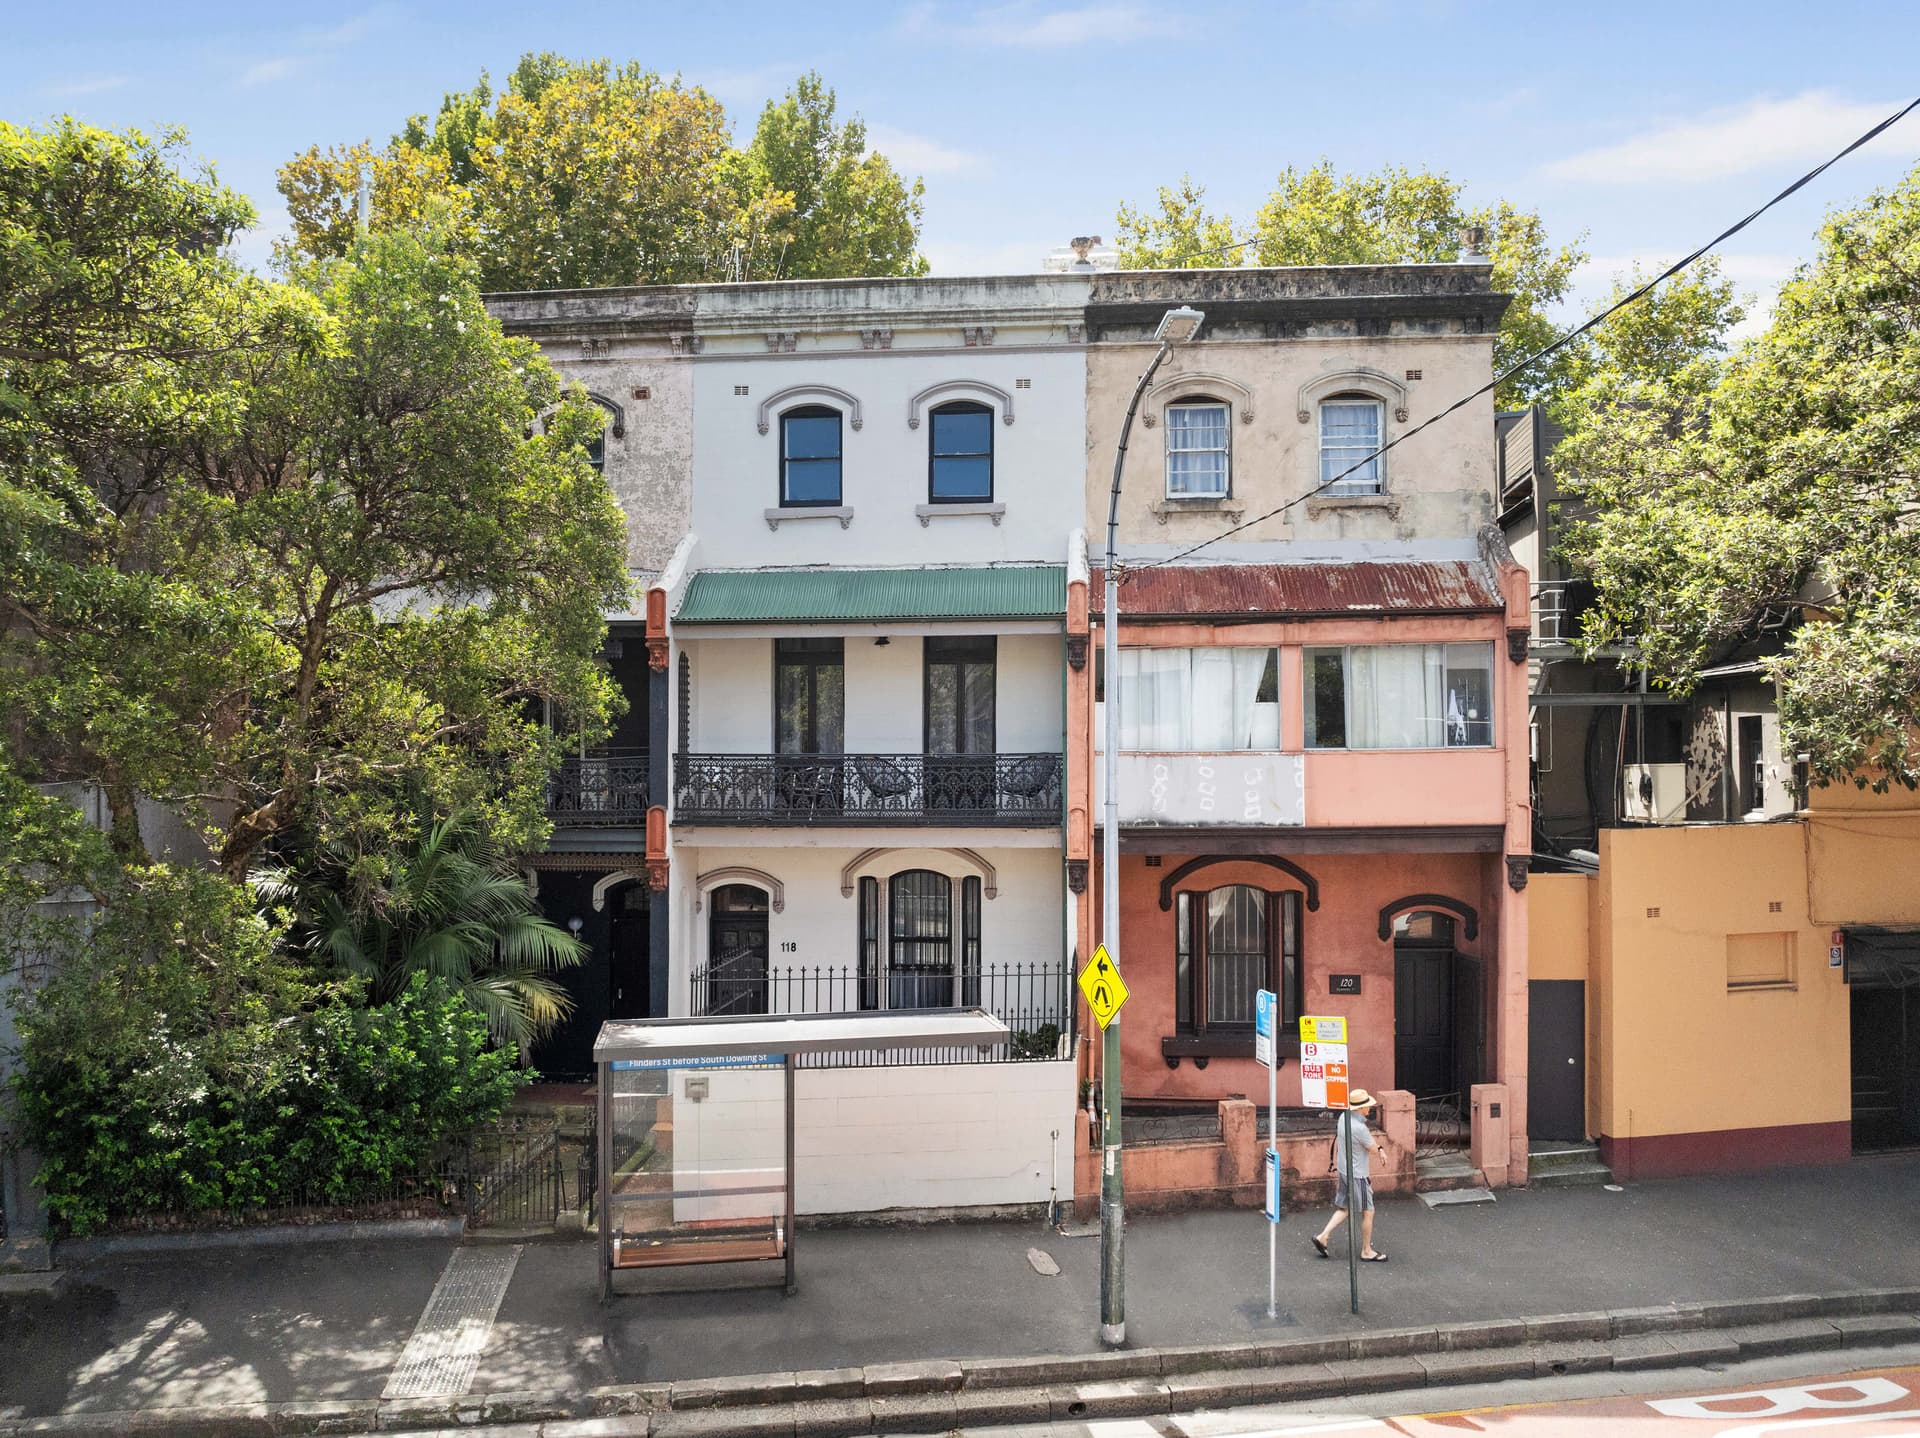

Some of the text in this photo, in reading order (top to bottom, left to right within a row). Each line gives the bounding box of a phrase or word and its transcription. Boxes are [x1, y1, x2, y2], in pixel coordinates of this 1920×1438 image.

[781, 942, 797, 953] 118
[1340, 978, 1353, 987] 120
[629, 1060, 661, 1068] Flinders
[662, 1058, 671, 1066] St
[672, 1057, 700, 1066] before
[700, 1056, 725, 1065] South
[1304, 1064, 1321, 1072] BUS
[1331, 1066, 1341, 1074] NO
[1303, 1071, 1322, 1079] ZONE
